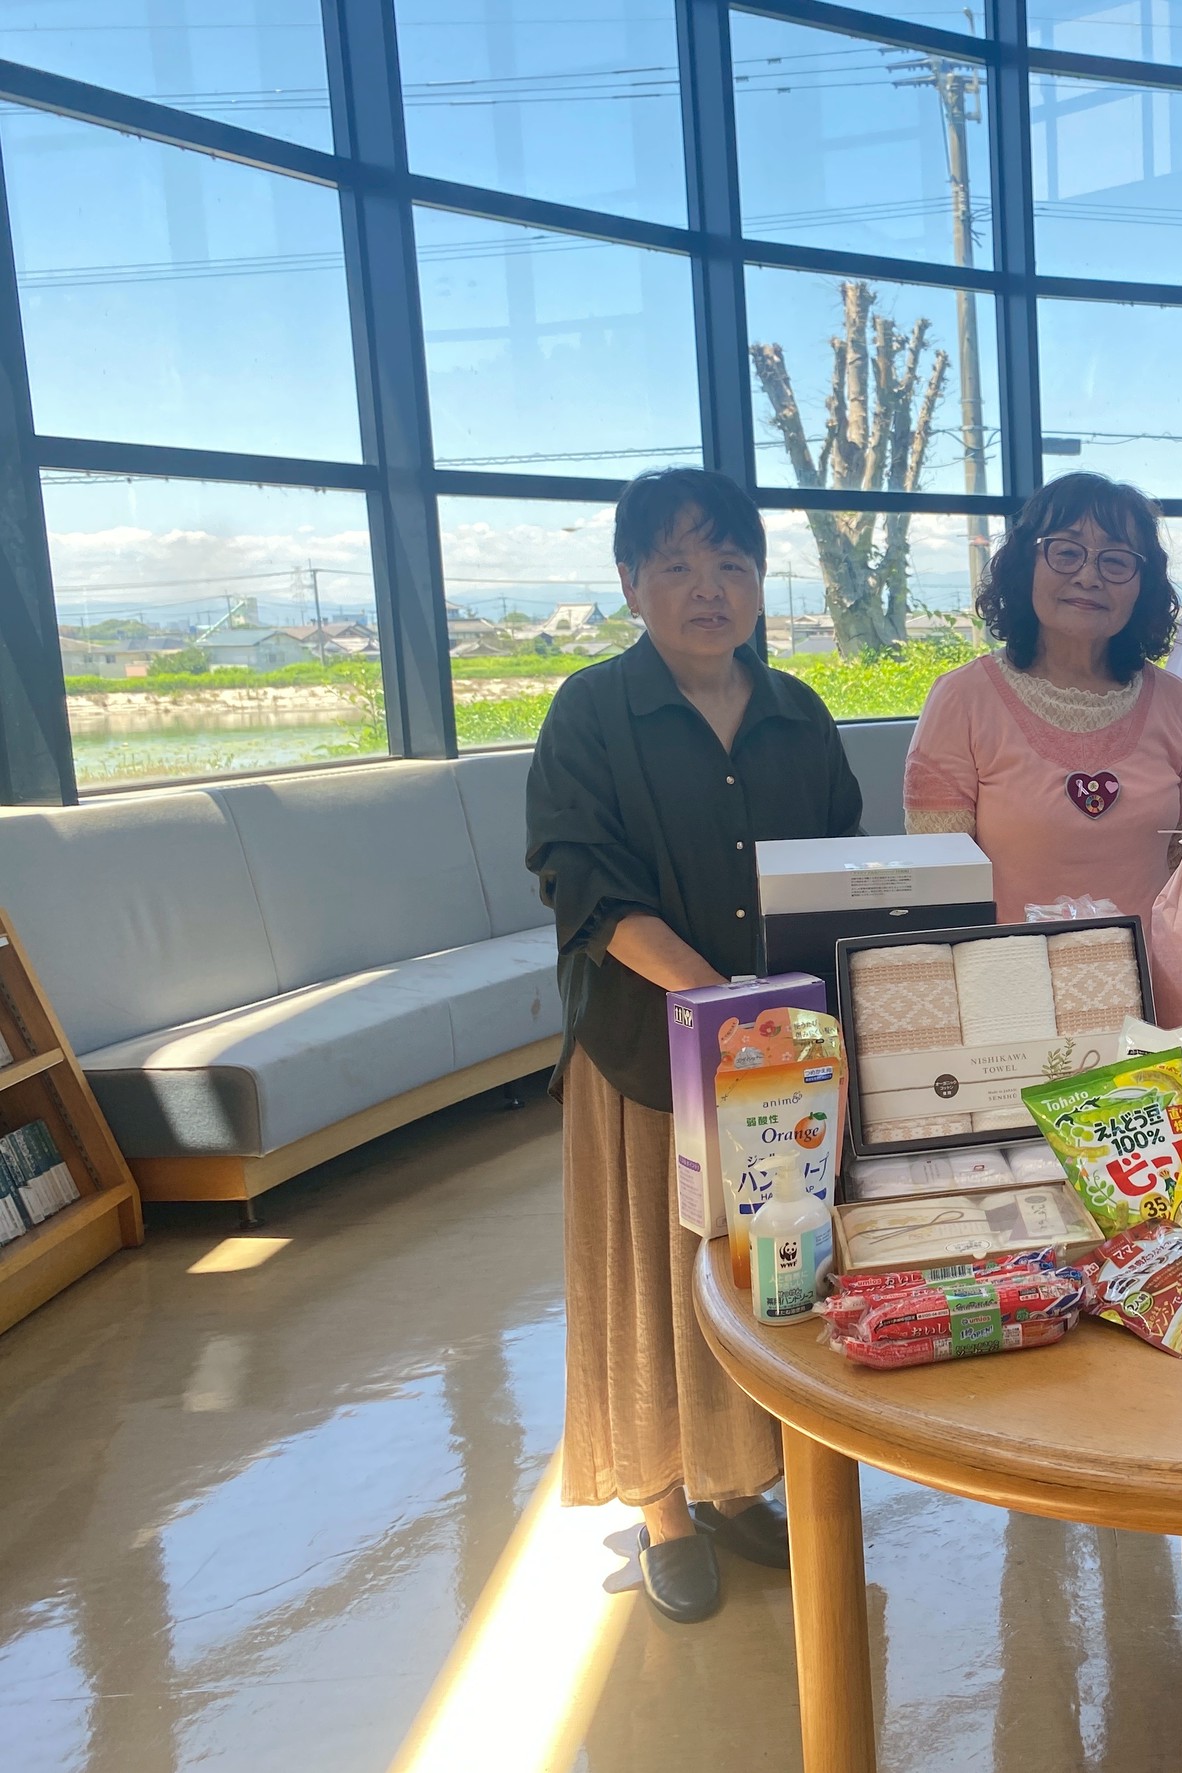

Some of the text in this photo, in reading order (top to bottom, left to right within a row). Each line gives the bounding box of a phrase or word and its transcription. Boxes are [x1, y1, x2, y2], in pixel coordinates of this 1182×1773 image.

[971, 1052, 1027, 1066] NISHIKAWA
[983, 1064, 1018, 1075] TOWEL
[1044, 1091, 1089, 1112] Tohato
[746, 1114, 779, 1127] 弱酸性
[1094, 1103, 1164, 1143] えんどう豆
[761, 1127, 820, 1144] Orange
[1110, 1128, 1166, 1156] 100%
[1143, 1197, 1168, 1219] 35
[780, 1261, 797, 1269] WWF
[969, 1316, 991, 1324] umios
